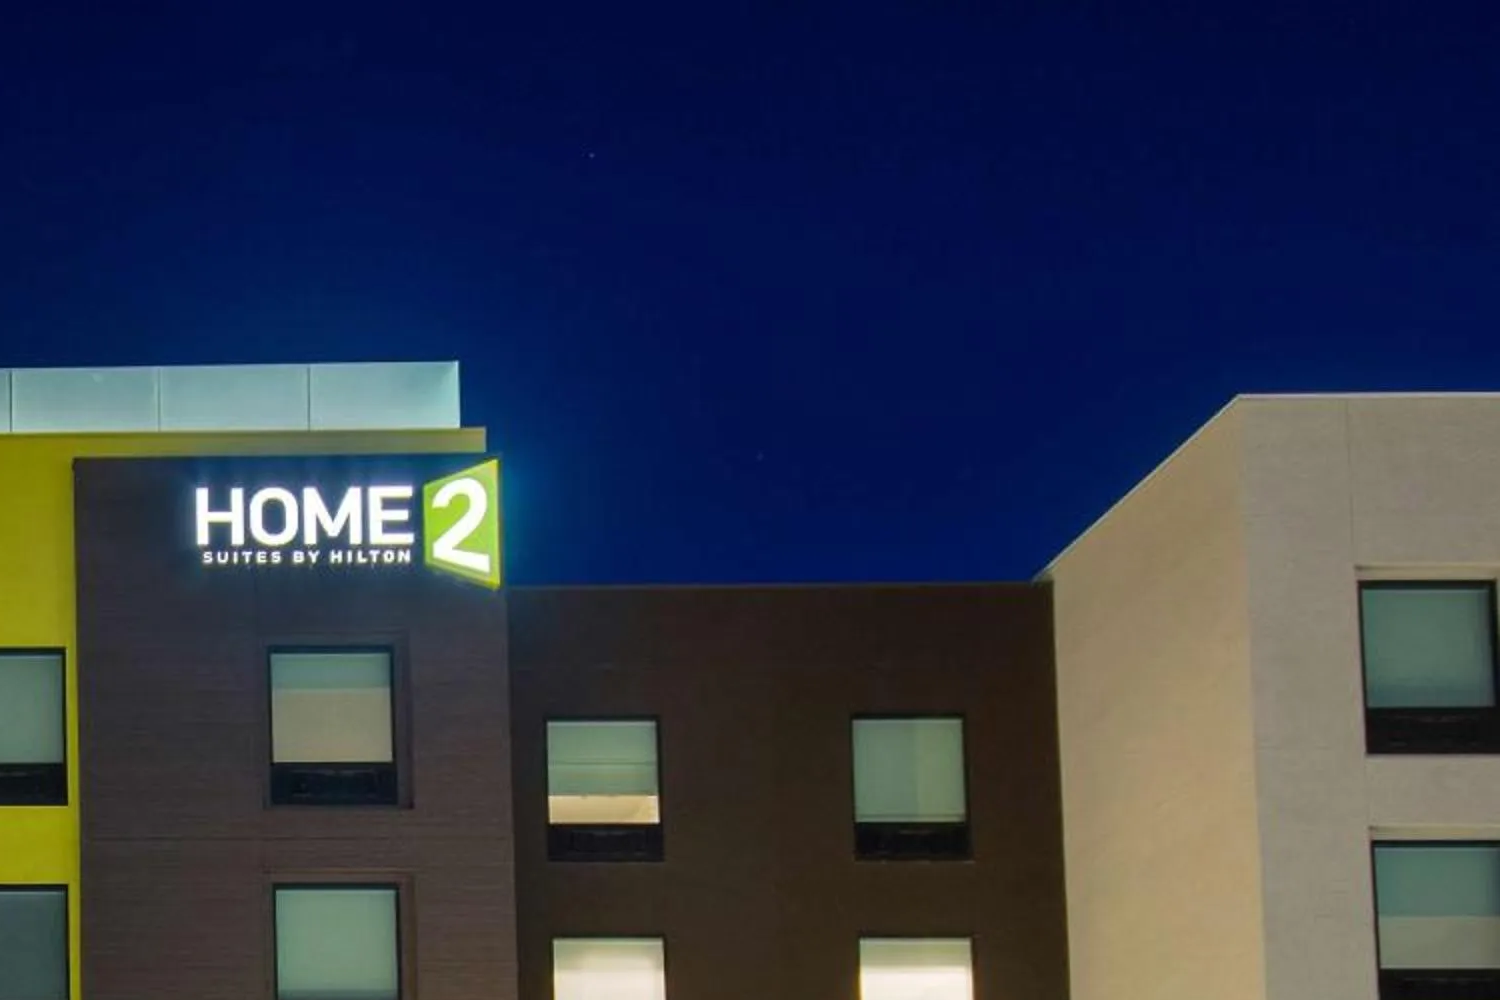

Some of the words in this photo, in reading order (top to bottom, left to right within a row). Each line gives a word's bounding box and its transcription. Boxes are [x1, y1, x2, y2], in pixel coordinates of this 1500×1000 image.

[195, 486, 415, 546] HOME
[431, 476, 491, 573] 2
[203, 551, 282, 564] SUITES
[292, 550, 319, 564] BY
[330, 549, 412, 564] HILTON
